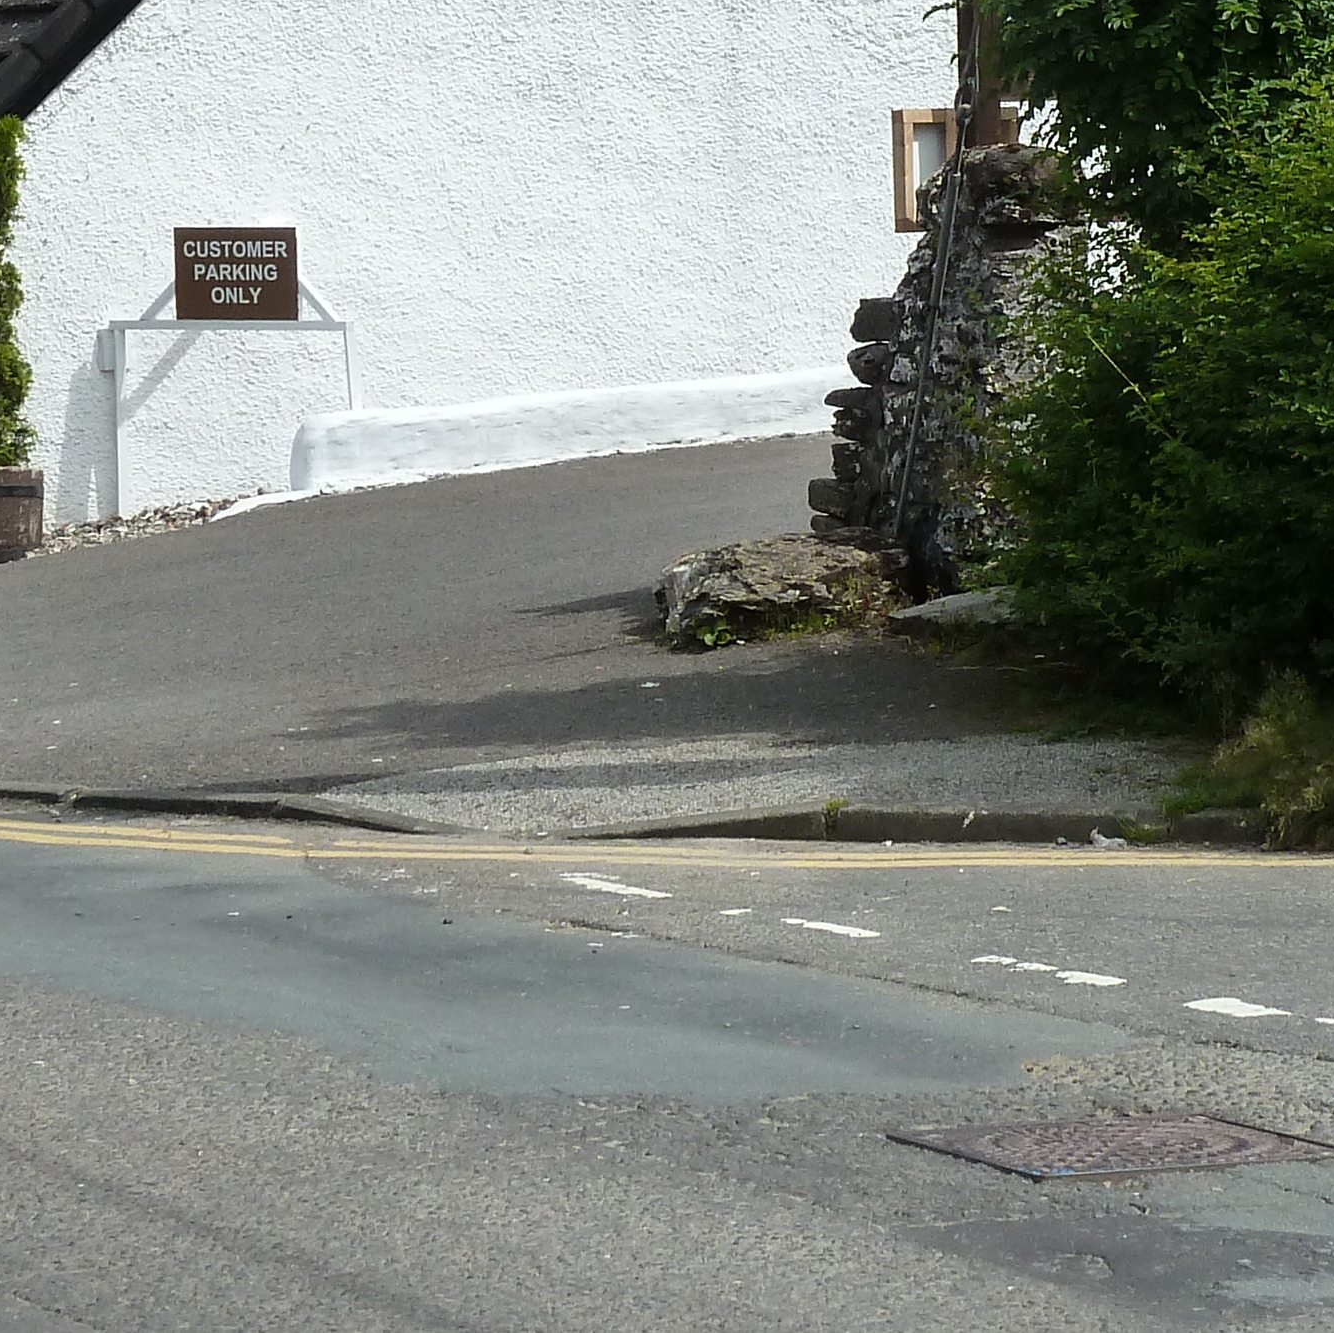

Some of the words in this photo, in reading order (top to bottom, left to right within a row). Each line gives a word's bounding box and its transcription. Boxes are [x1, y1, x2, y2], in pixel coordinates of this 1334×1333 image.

[183, 240, 288, 258] CUSTOMER
[193, 263, 278, 282] PARKING
[210, 286, 263, 305] ONLY
